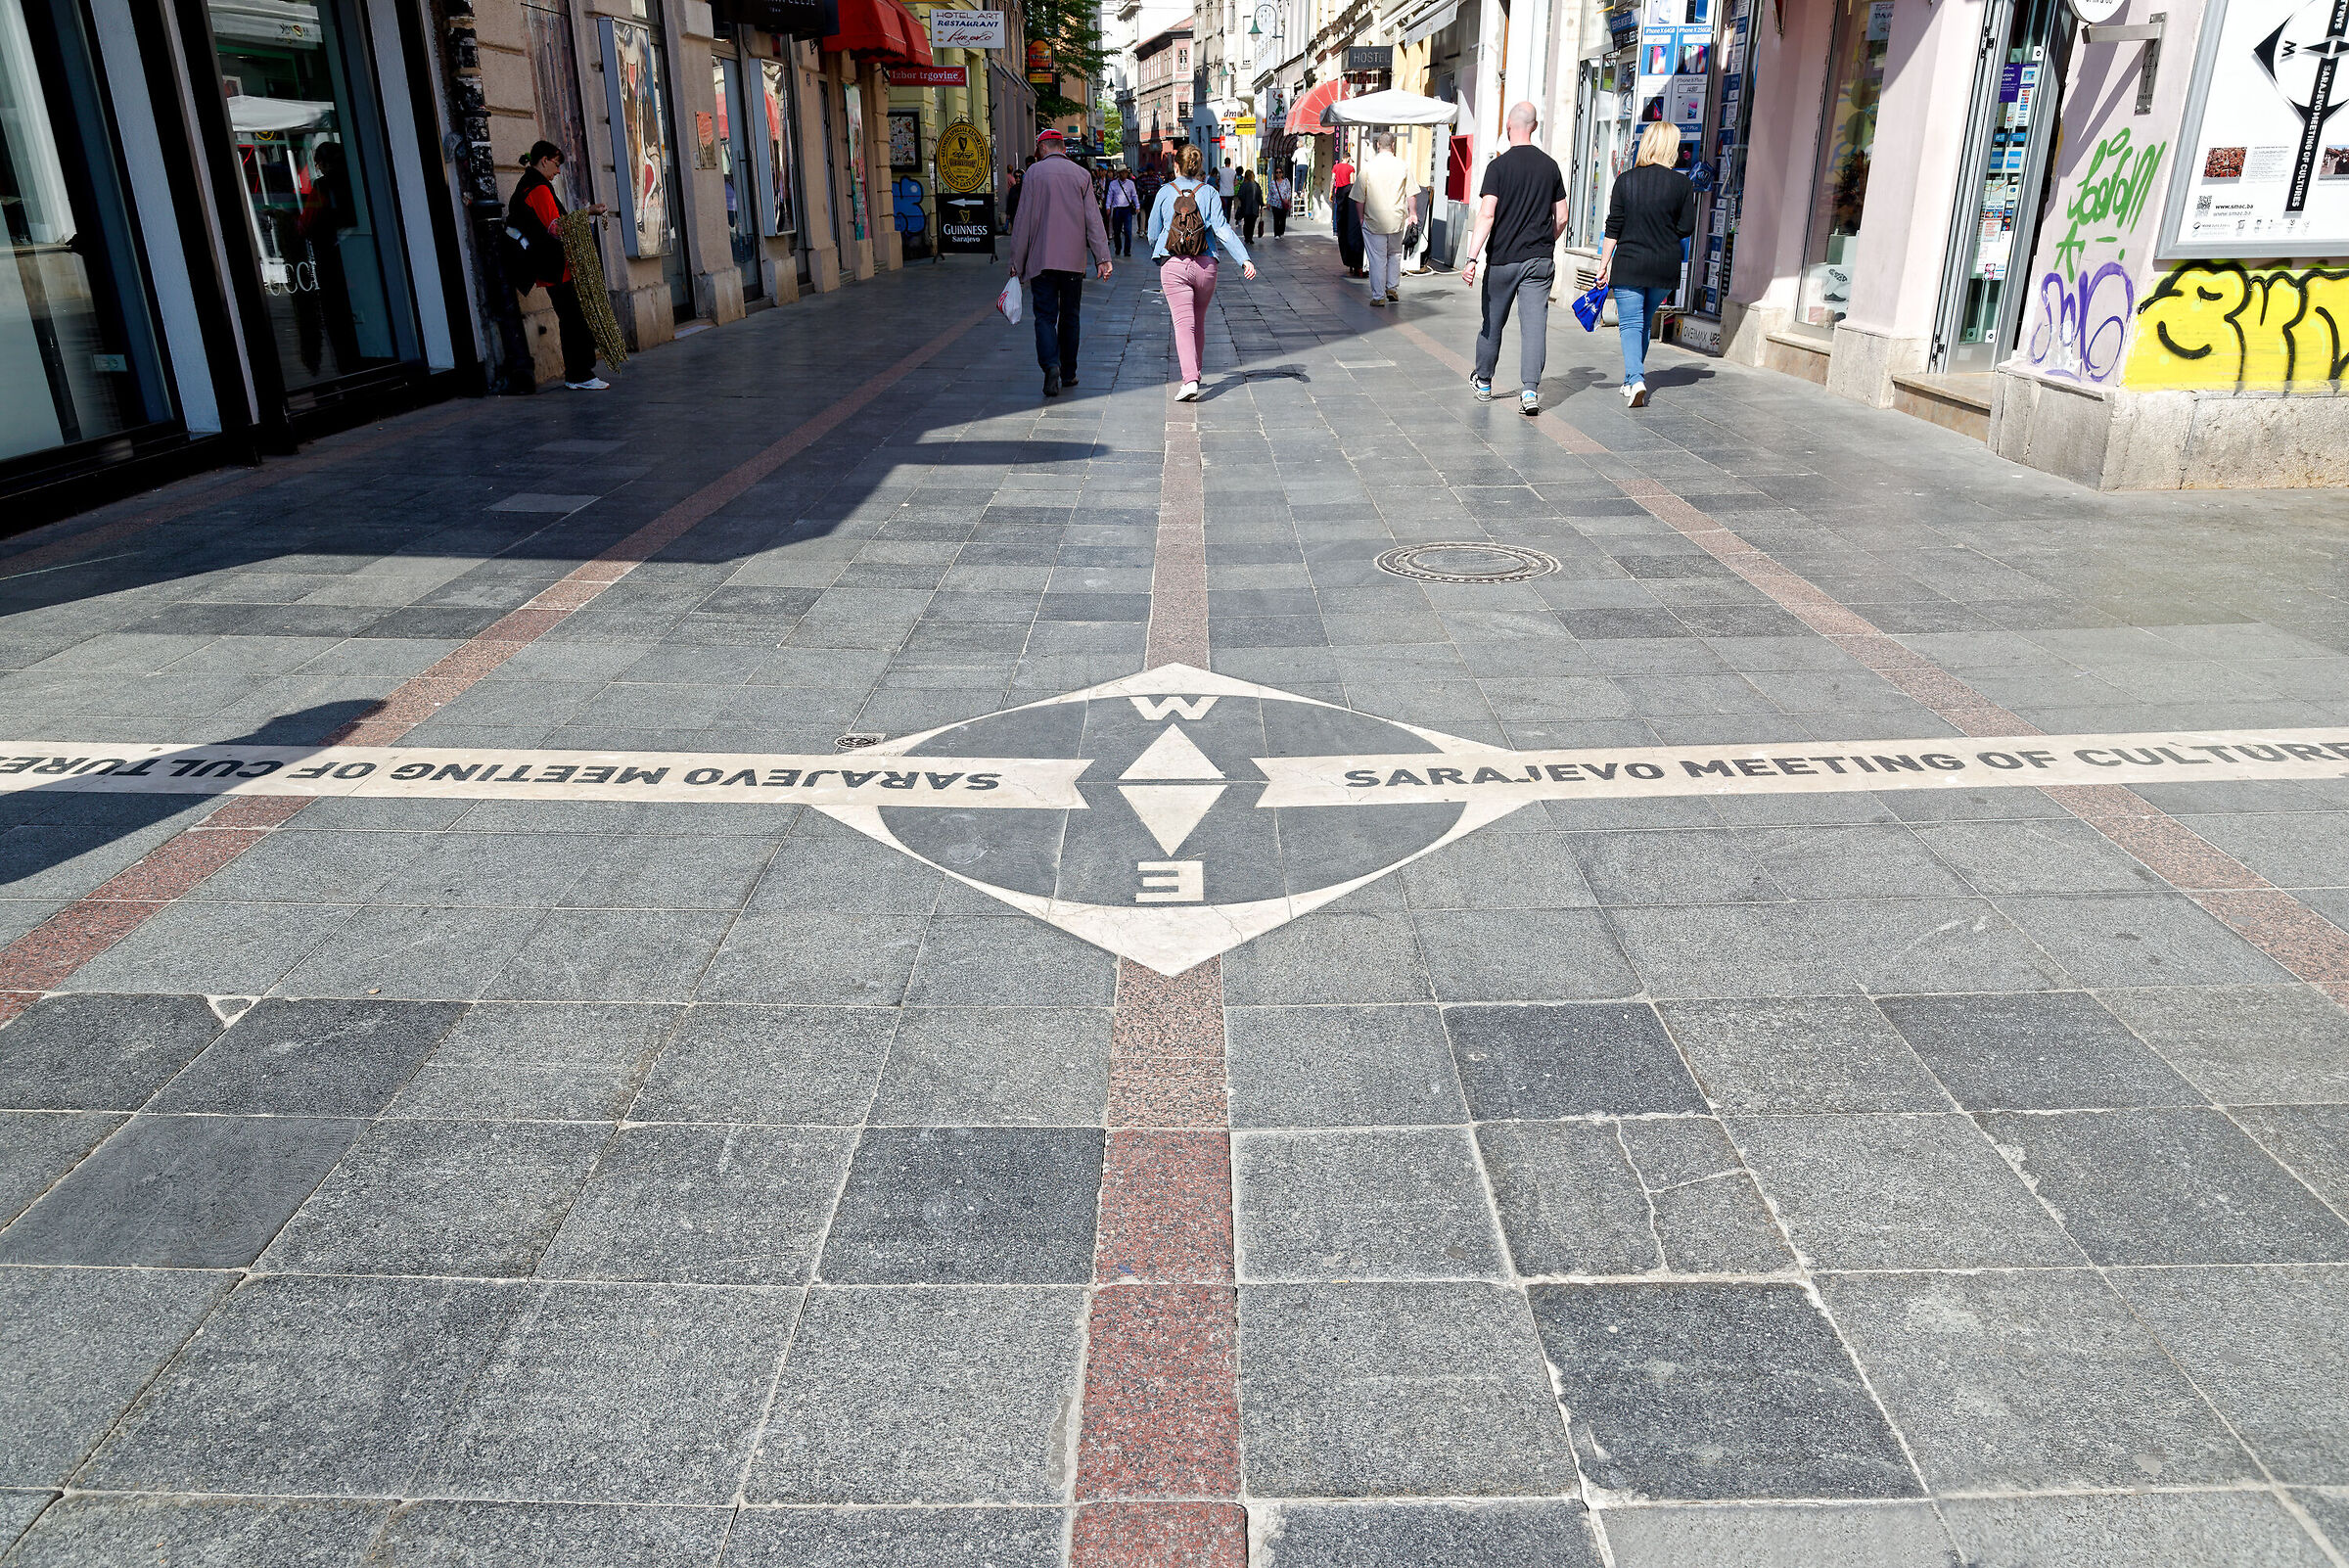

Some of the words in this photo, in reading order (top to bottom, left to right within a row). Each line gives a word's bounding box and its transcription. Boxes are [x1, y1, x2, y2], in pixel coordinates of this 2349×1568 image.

[2334, 0, 2348, 29] SARA
[1354, 52, 1390, 63] HOSTEL
[892, 70, 917, 79] Izbor
[920, 70, 958, 81] trgovine
[2316, 65, 2332, 112] SARAJEVO
[1223, 109, 1237, 117] dm
[2304, 112, 2320, 151] MEETING
[2302, 151, 2312, 163] OF
[2291, 163, 2309, 208] CULTURES
[944, 224, 988, 235] GUINNESS
[951, 235, 981, 244] Sarajevo
[1128, 696, 1221, 720] W
[288, 761, 379, 780] OF
[391, 762, 671, 785] MEETING
[684, 766, 1002, 791] SARAJEVO
[1344, 761, 1666, 788] SARAJEVO
[1679, 753, 1966, 778] MEETING
[1976, 750, 2058, 770] OF
[1135, 860, 1204, 903] E
